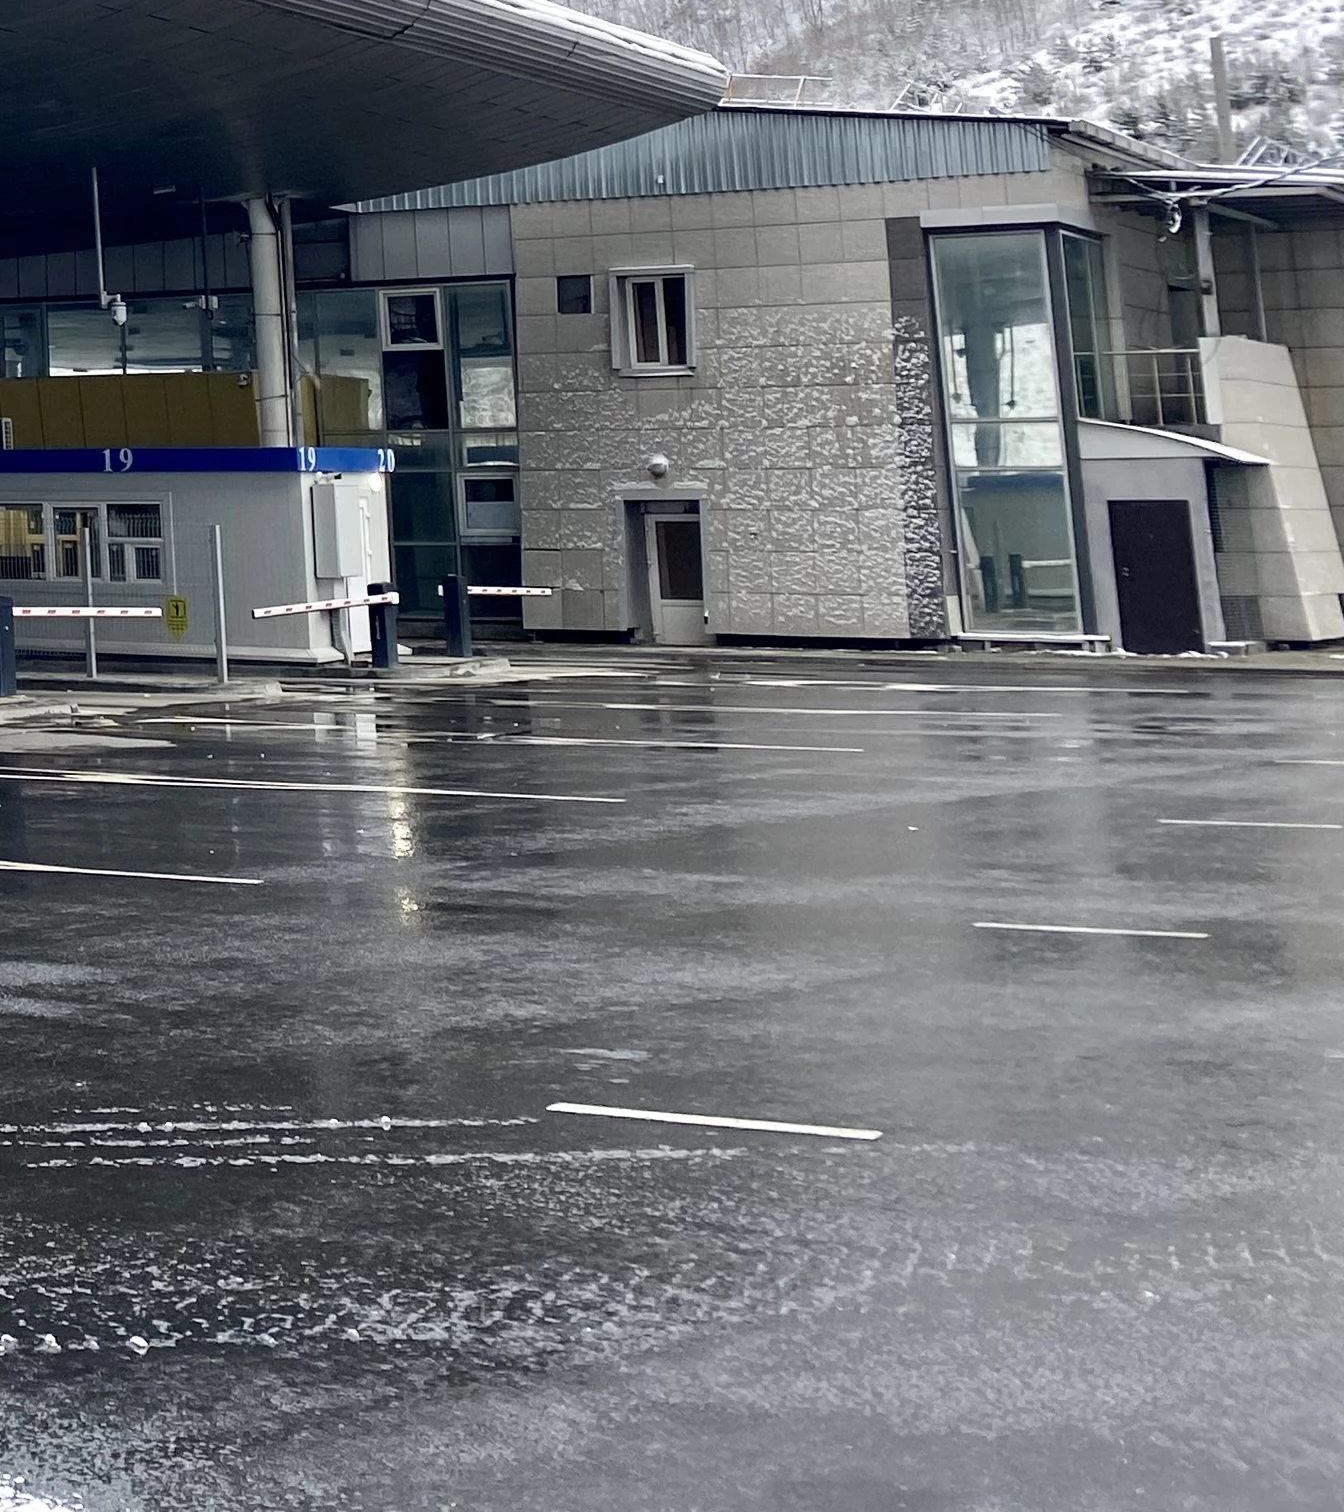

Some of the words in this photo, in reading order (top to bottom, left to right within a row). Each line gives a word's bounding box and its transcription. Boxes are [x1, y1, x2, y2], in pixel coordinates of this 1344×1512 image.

[102, 448, 133, 472] 19
[298, 447, 316, 472] 19
[377, 448, 396, 473] 20
